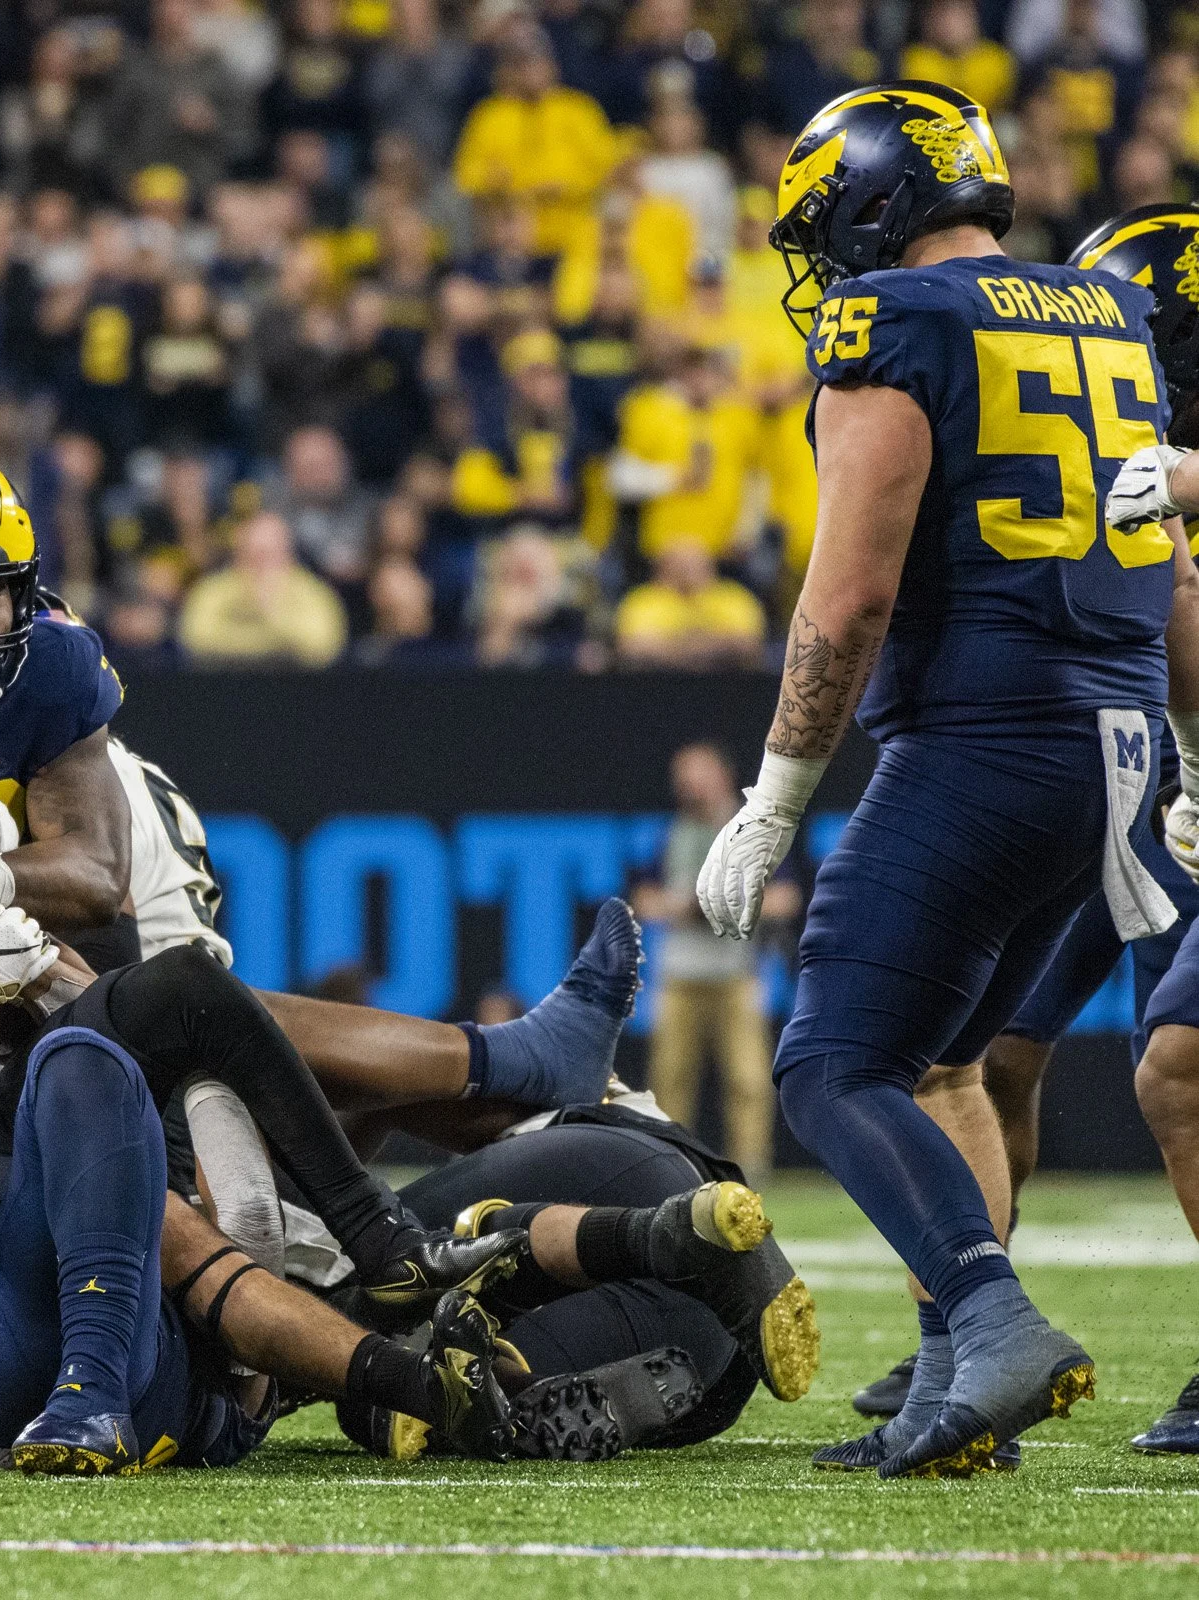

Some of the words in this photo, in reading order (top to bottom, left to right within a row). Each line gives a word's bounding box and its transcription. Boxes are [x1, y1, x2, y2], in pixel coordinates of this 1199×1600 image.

[814, 297, 878, 367] 55
[977, 277, 1126, 328] GRAHAM
[973, 330, 1175, 569] 55
[1113, 728, 1144, 772] M
